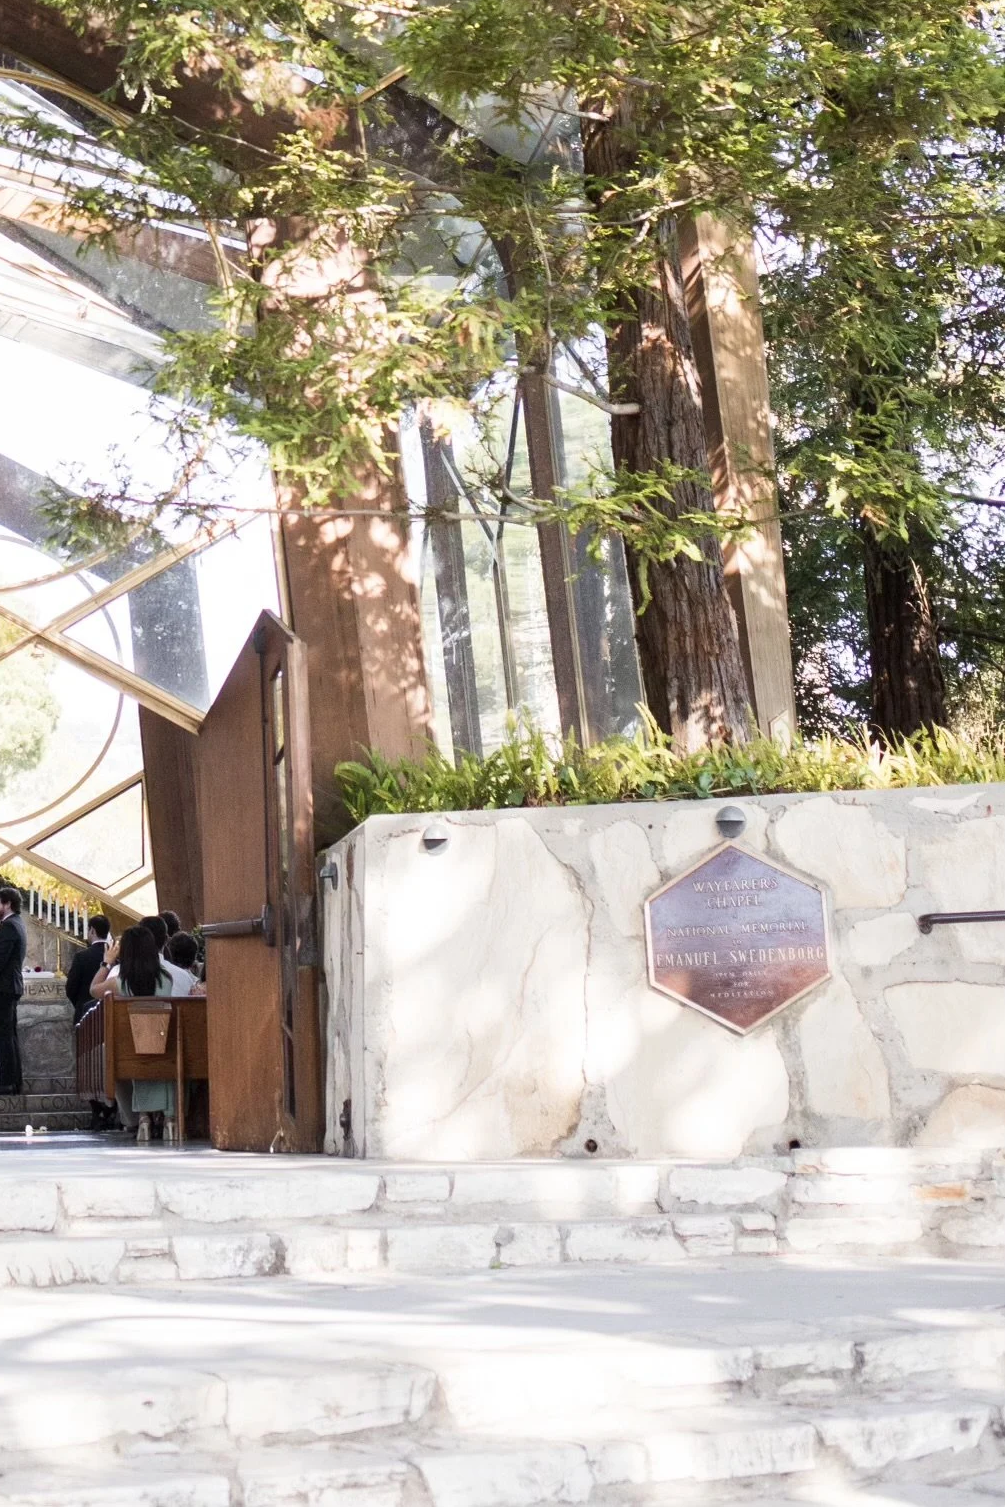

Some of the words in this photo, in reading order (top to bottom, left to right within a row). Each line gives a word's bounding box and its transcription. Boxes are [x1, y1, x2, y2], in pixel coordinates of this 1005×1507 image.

[692, 877, 779, 893] WAYFARERS
[707, 894, 761, 909] CHAPEL
[667, 924, 731, 939] NATIONAL
[741, 920, 808, 935] MEMORIAL
[656, 951, 721, 967] EMANUEL
[729, 945, 825, 964] SWEDENBORG
[24, 984, 67, 996] HEAVE
[709, 989, 774, 999] MEDITATION
